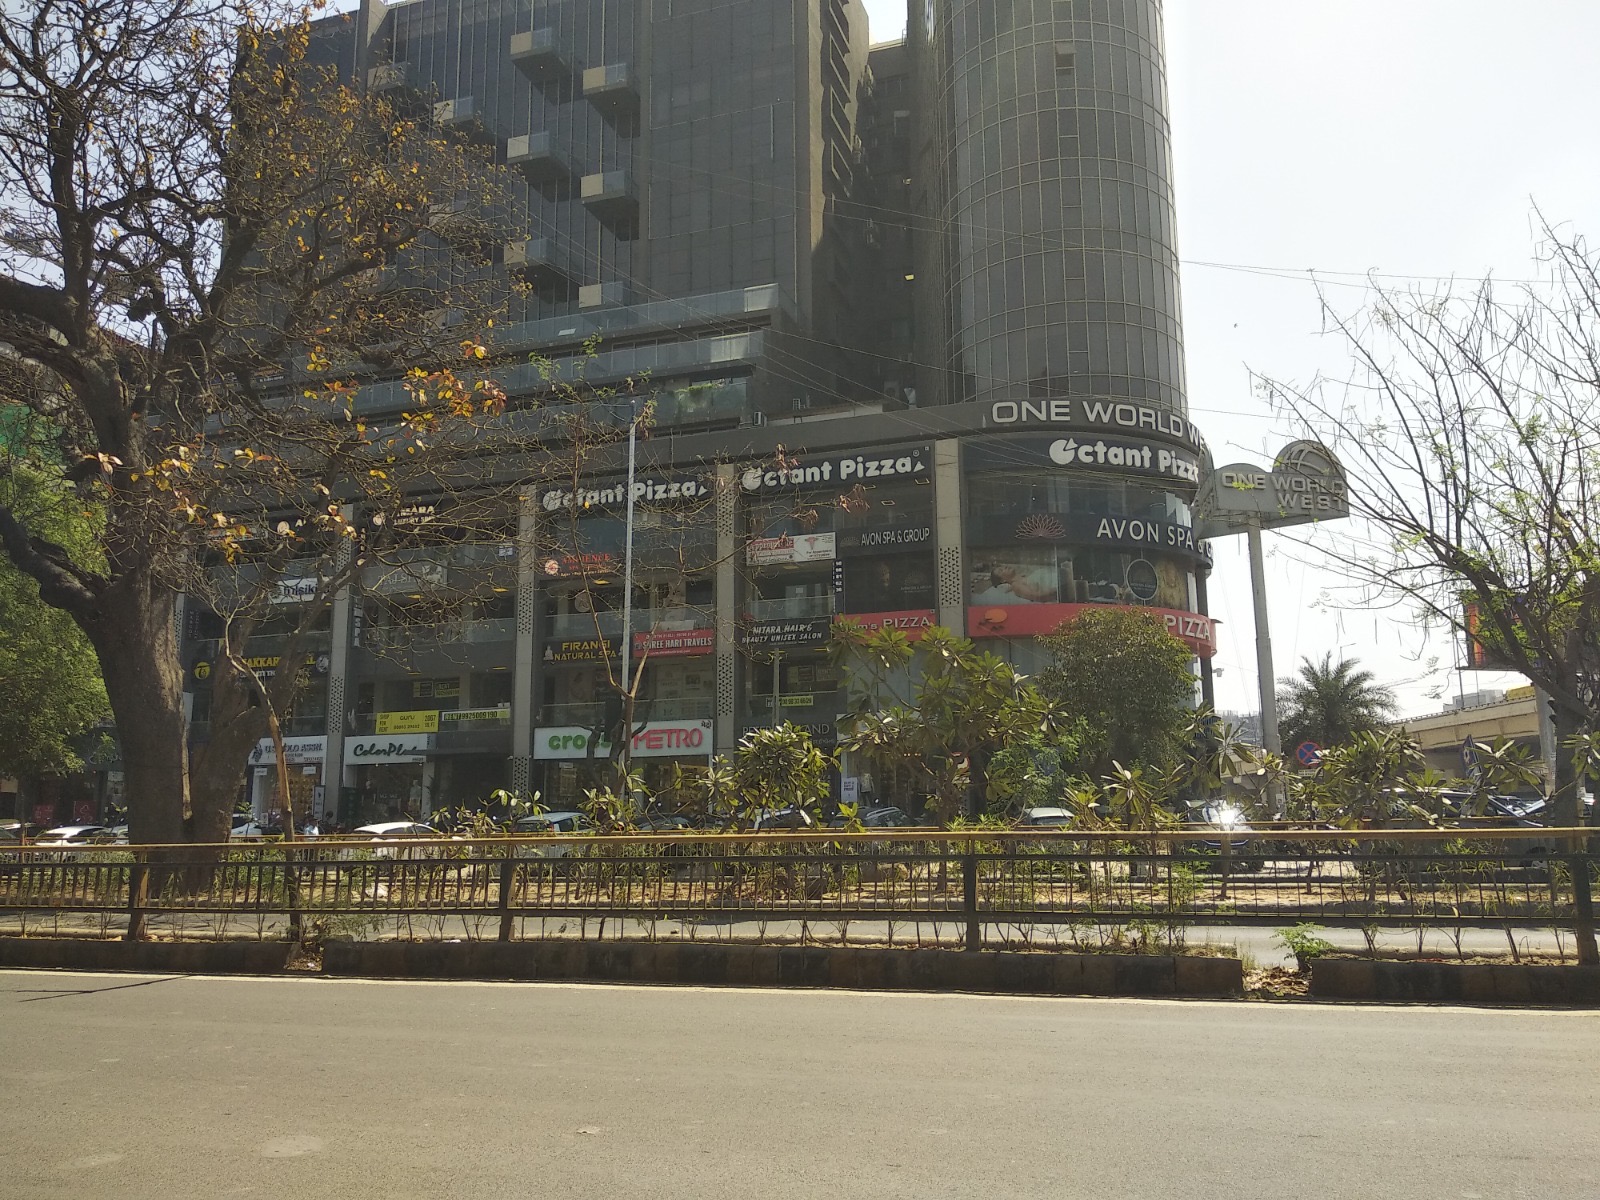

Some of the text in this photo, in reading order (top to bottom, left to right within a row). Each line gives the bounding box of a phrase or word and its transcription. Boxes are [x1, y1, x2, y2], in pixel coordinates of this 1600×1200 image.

[992, 400, 1071, 424] ONE
[1081, 400, 1184, 438] WORLD
[1049, 437, 1152, 469] Octant
[741, 456, 913, 491] Octant Pizza
[1222, 472, 1345, 494] ONE WORLD
[631, 479, 696, 501] Pizza
[1278, 494, 1345, 511] WEST
[861, 528, 930, 547] AVON SPA & GROUP
[1097, 518, 1159, 542] AVON
[1167, 524, 1194, 551] SPA
[753, 626, 782, 635] NITARA
[783, 624, 803, 634] HAIR
[883, 616, 930, 629] PIZZA
[1163, 614, 1211, 640] PIZZA
[562, 640, 611, 651] FIRANGI
[665, 639, 682, 649] HARI
[684, 637, 713, 648] TRAVELS
[742, 631, 822, 644] BEAUTY UNISEX SALON
[554, 650, 617, 662] NATURAL SPA
[633, 728, 703, 750] METRO
